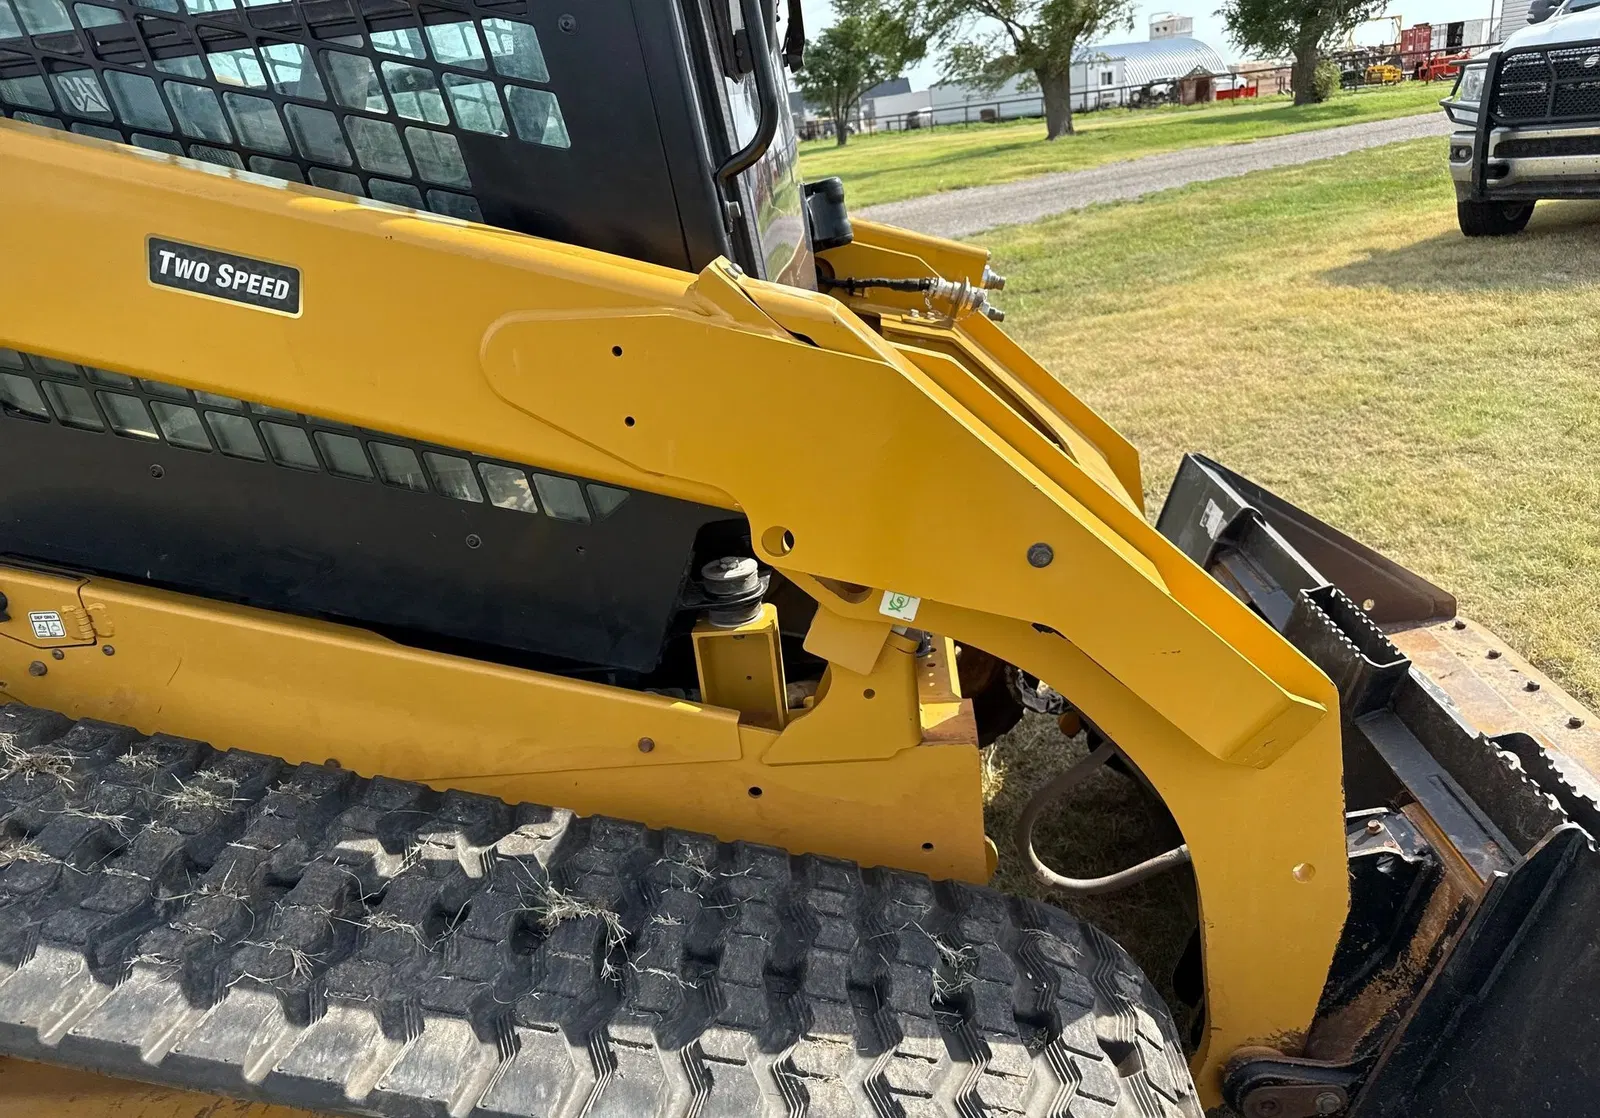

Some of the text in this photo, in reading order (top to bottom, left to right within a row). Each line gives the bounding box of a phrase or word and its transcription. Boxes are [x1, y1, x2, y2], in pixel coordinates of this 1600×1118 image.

[57, 75, 111, 112] CAT
[159, 250, 290, 300] TWO SPEED
